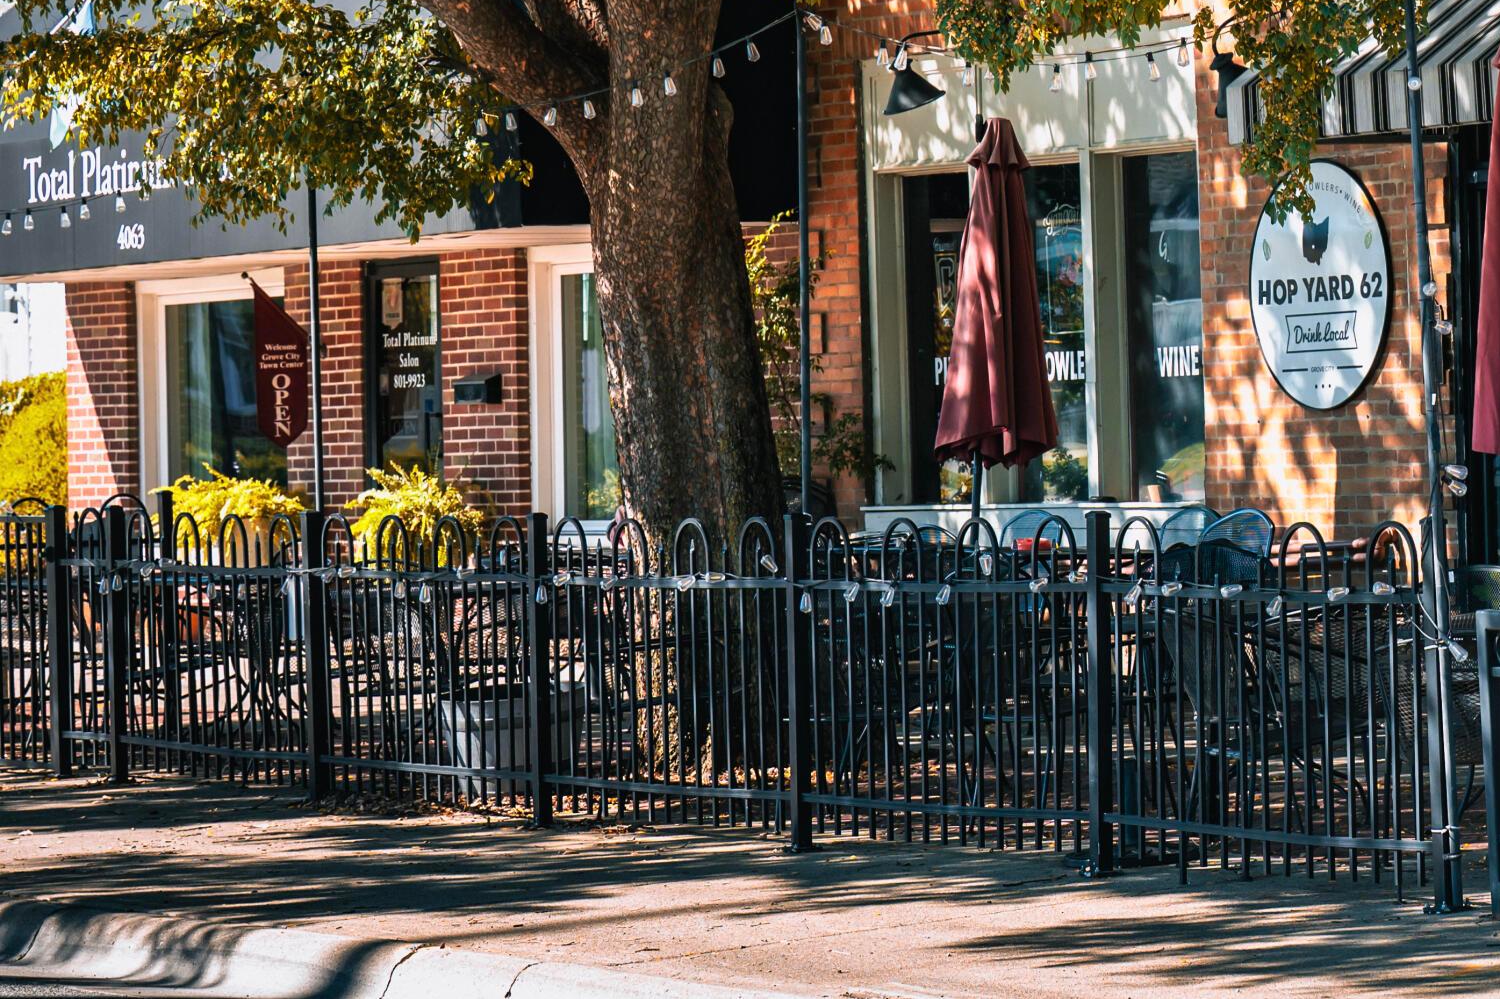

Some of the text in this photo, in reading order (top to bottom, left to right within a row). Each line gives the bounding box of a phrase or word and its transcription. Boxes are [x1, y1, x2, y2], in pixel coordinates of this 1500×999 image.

[23, 149, 75, 204] Total
[1343, 191, 1361, 214] WINE
[117, 222, 145, 250] 4063
[1258, 271, 1383, 306] HOP YARD 62
[382, 331, 437, 347] Total Platinum
[1293, 321, 1323, 345] Drink
[261, 352, 301, 361] Grove City
[265, 343, 297, 351] Welcome
[259, 361, 304, 369] Town Center
[399, 352, 420, 368] Salon
[1157, 345, 1200, 378] WINE
[393, 373, 426, 389] 801-9923
[271, 373, 292, 438] OPEN
